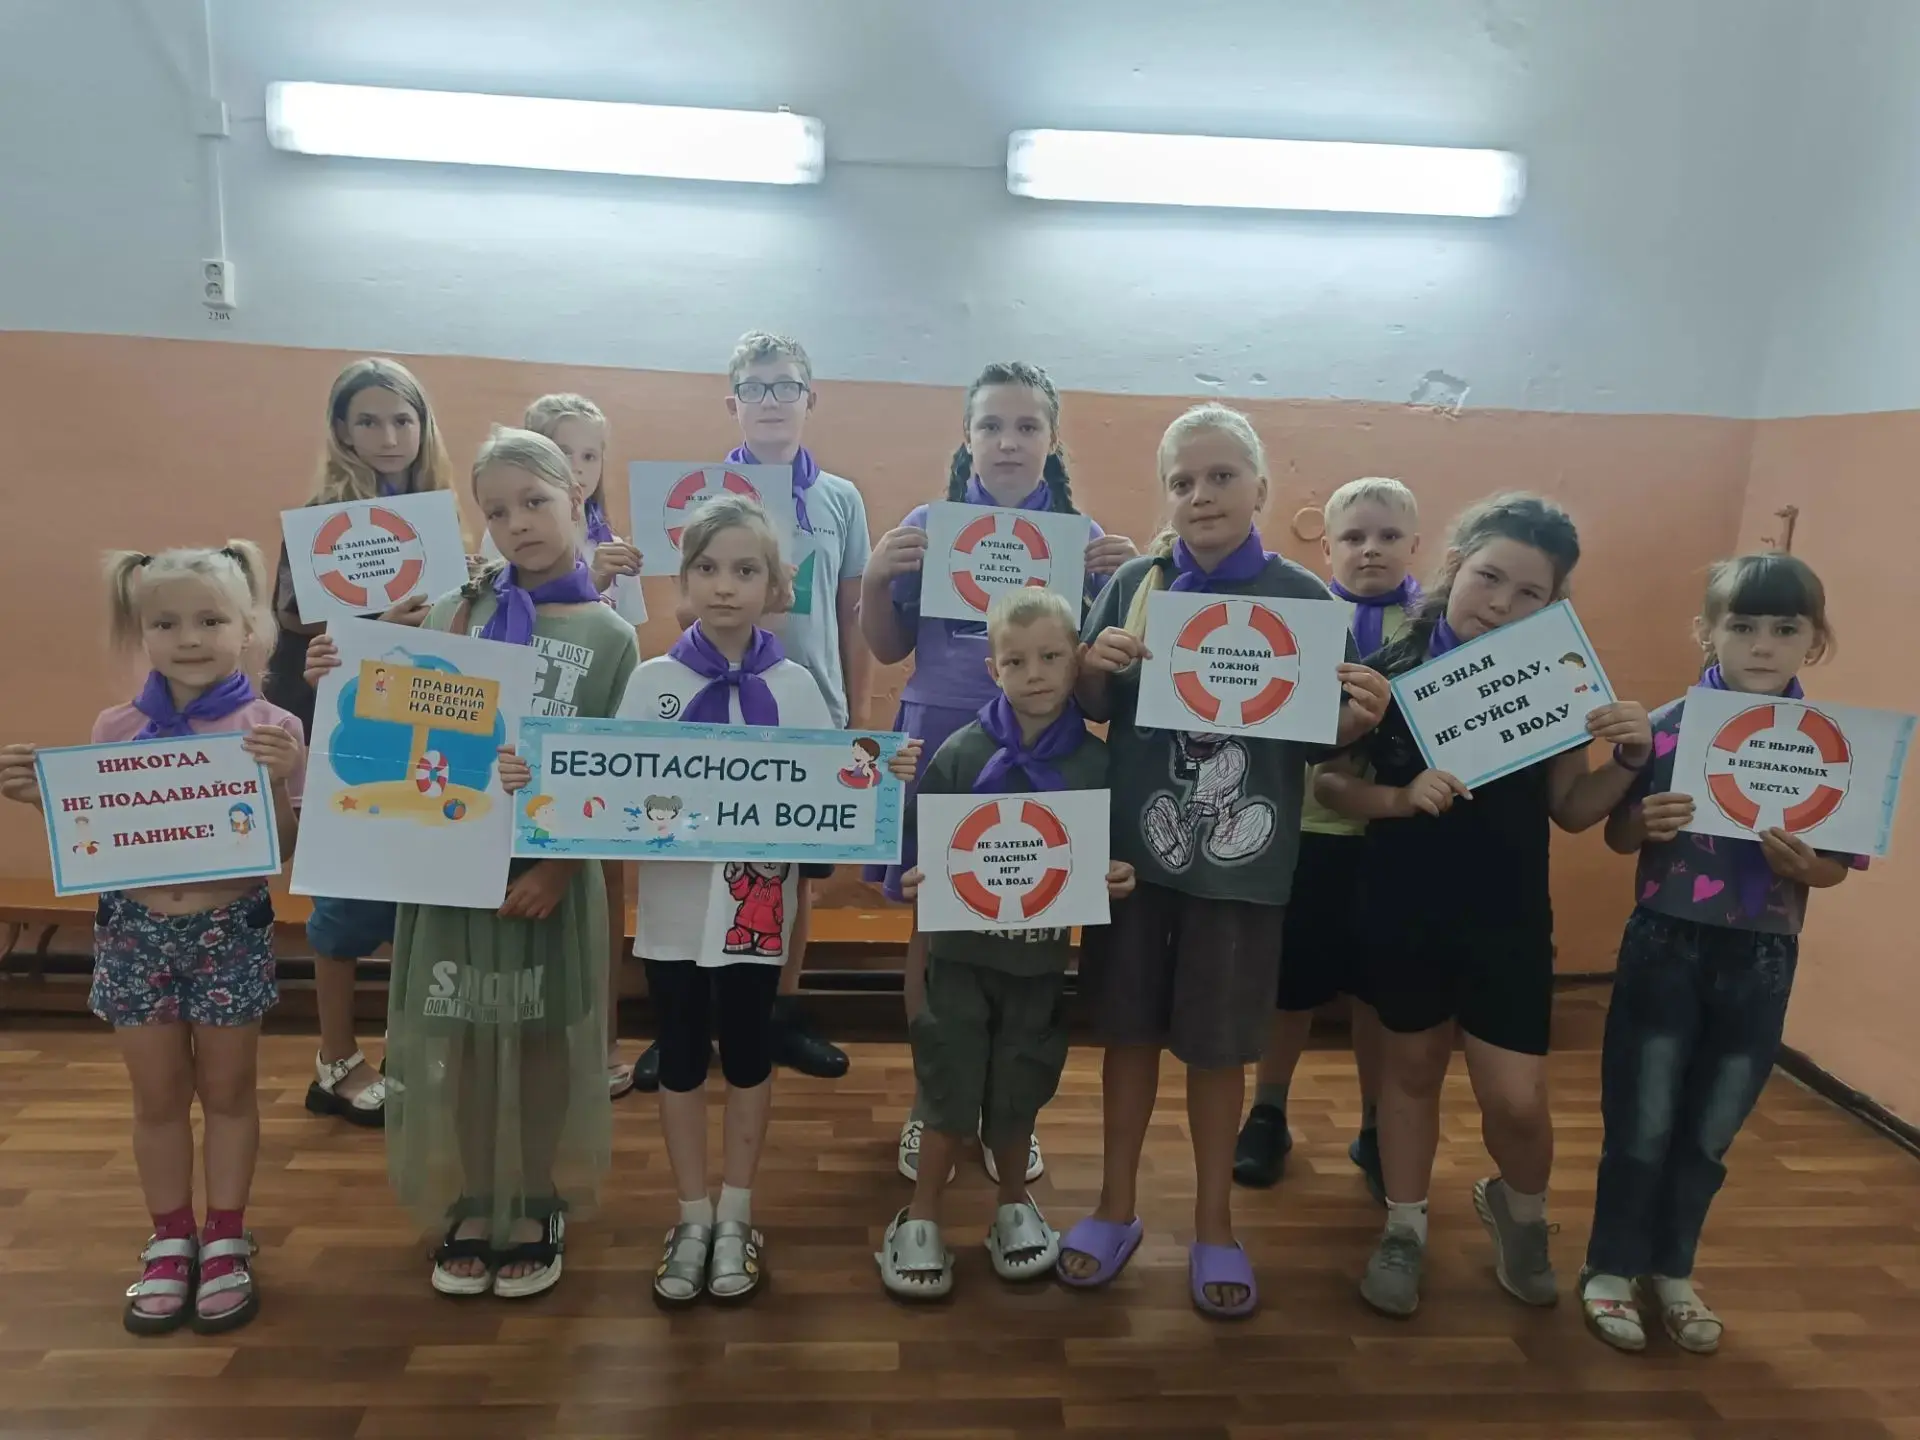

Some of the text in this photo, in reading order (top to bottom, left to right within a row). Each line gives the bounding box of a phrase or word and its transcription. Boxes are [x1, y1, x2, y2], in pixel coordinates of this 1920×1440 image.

[330, 535, 400, 551] НЕ ЗАПЛЫВАЙ
[980, 540, 1024, 551] КУПАЙСЯ
[353, 546, 400, 559] ГРАНИЦЫ
[991, 553, 1012, 561] ТАМ,
[356, 559, 385, 569] ЗОНЫ
[980, 563, 1021, 573] ГДЕ ЕСТЬ
[348, 567, 396, 581] КУПАНИЯ
[975, 574, 1023, 585] ВЗРОСЛЫЕ
[557, 643, 591, 665] JUST
[1200, 646, 1271, 658] НЕ ПОДАВАЙ
[1210, 661, 1259, 671] ЛОЖНОЙ
[1209, 675, 1257, 686] ТРЕВОГИ
[1414, 654, 1496, 701] НЕ ЗНАЯ
[1477, 660, 1551, 699] БРОДУ,
[412, 677, 484, 699] ПРАВИЛА
[410, 690, 485, 710] ПОВЕДЕНИЯ
[1435, 694, 1530, 746] НЕ СУЙСЯ
[1499, 703, 1570, 743] В ВОДУ
[1749, 740, 1815, 755] НЕ НЫРЯЙ
[97, 751, 210, 773] НИКОГДА
[550, 750, 807, 783] БЕЗОПАСНОСТЬ
[1728, 758, 1829, 778] В НЕЗНАКОМЫХ
[61, 780, 258, 812] НЕ ПОДДАВАЙСЯ
[1749, 781, 1800, 796] МЕСТАХ
[717, 801, 857, 832] НА ВОДЕ
[113, 823, 215, 847] ПАНИКЕ!
[977, 838, 1044, 849] НЕ ЗАТЕВАЙ
[983, 853, 1038, 863] ОПАСНЫХ
[1000, 866, 1020, 874] ИГР
[987, 877, 1034, 886] НА ВОДЕ
